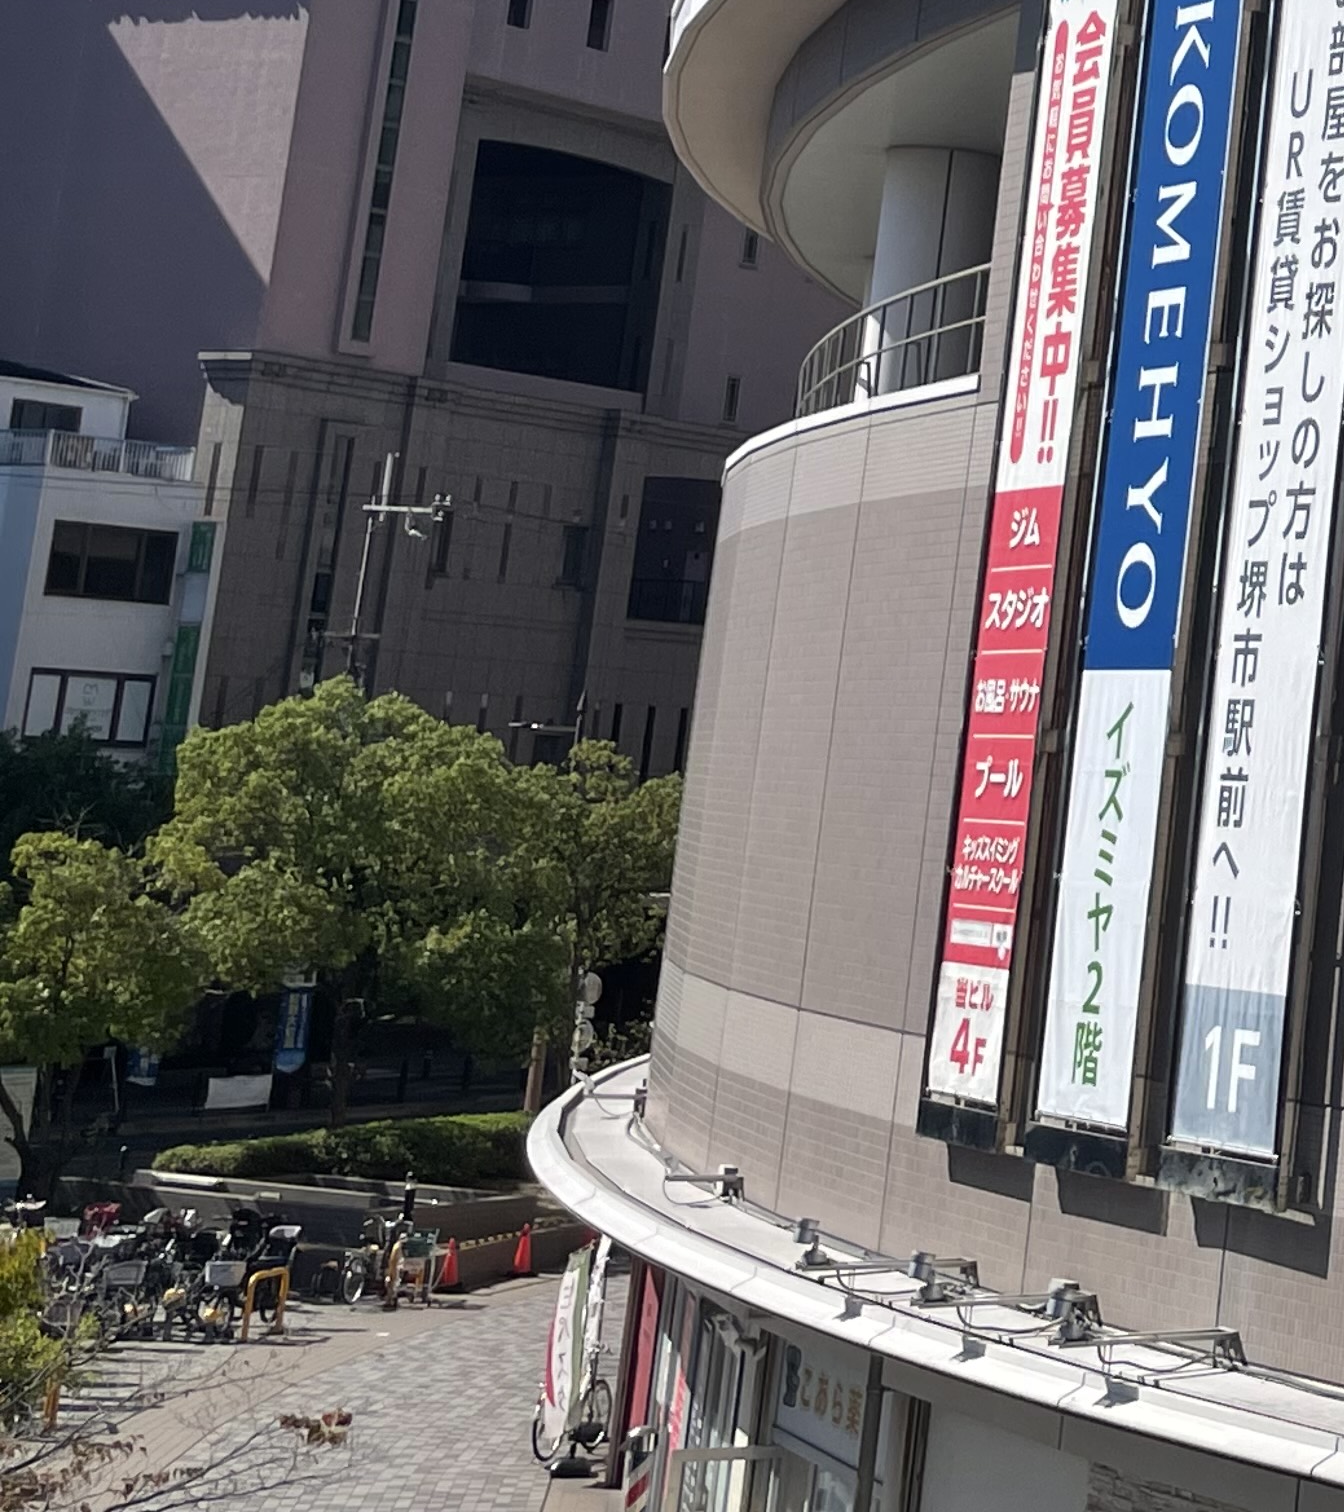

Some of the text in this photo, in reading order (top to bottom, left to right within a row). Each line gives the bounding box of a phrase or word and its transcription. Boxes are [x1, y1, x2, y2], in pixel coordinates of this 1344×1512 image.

[1036, 10, 1108, 466] 会員募集中!!
[1008, 506, 1041, 550] ジム
[984, 586, 1050, 631] スタジオ
[974, 754, 1023, 798] プール
[961, 833, 1021, 865] キッズスイミング
[1070, 699, 1135, 1089] イズミヤ2階
[955, 977, 994, 1013] 当ビル
[949, 1017, 988, 1076] 4F
[1203, 1025, 1261, 1114] 1F
